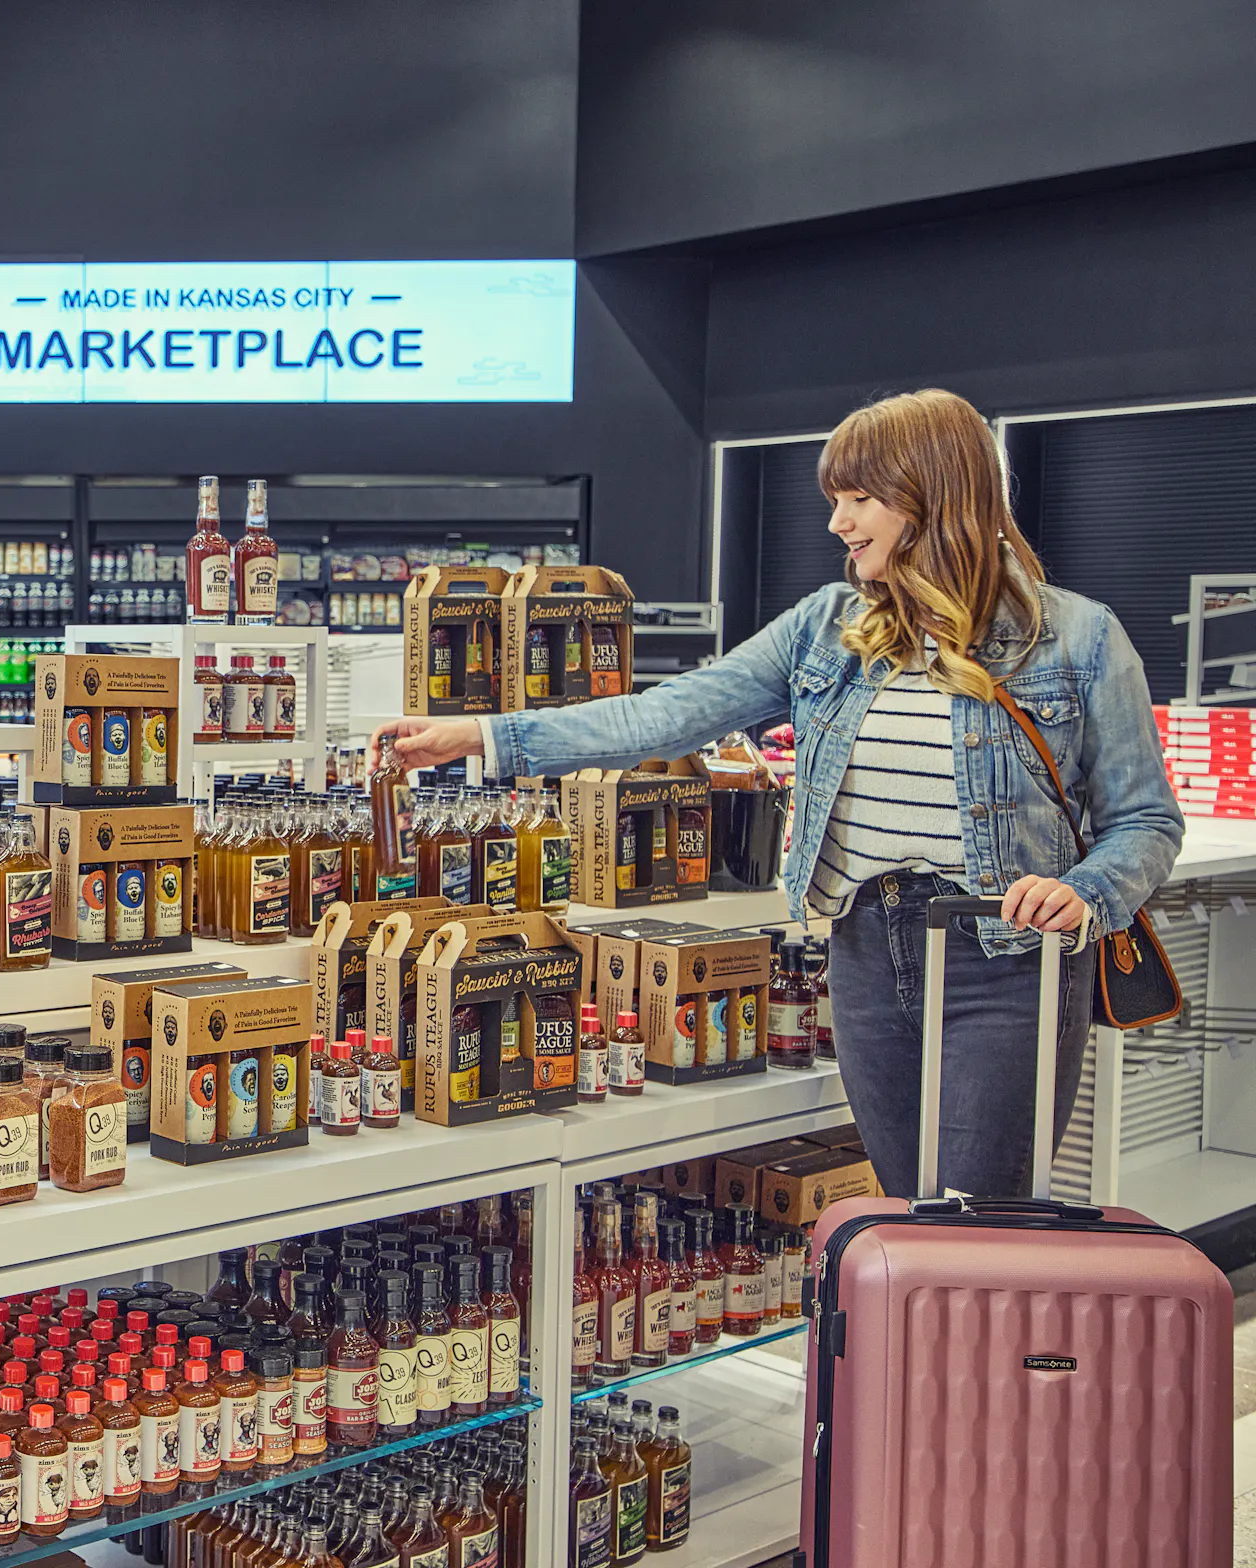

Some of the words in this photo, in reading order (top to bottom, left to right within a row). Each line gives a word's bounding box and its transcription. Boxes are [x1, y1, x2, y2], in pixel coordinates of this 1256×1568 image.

[63, 290, 136, 308] MADE
[146, 289, 169, 307] IN
[180, 288, 287, 308] KANSAS
[295, 288, 353, 307] CITY
[207, 585, 229, 594] WHISKE
[410, 603, 418, 660] TEAGUE
[508, 604, 516, 659] TEAGUE
[409, 665, 418, 708] RUFUS
[569, 786, 579, 849] TEAGUE
[595, 790, 604, 849] TEAGUE
[678, 843, 704, 852] AGUE
[569, 850, 578, 896] RUFUS
[594, 853, 603, 901] RUFUS
[489, 888, 516, 900] Vanilla
[262, 915, 285, 925] SPICE
[12, 926, 50, 946] Rhubarb
[23, 938, 44, 947] THYME
[317, 953, 327, 1023] TEAGUE
[456, 969, 512, 999] Saucin'
[514, 970, 523, 984] &
[541, 979, 557, 988] BBQ
[559, 977, 574, 986] KIT
[376, 962, 386, 1035] TEAGUE
[239, 1008, 263, 1019] Painfully
[264, 1007, 287, 1015] Delicious
[287, 1005, 298, 1013] Trio
[426, 973, 437, 1047] TEAGUE
[234, 1021, 241, 1029] of
[258, 1017, 272, 1026] Good
[273, 1016, 296, 1024] Favorites
[536, 1021, 573, 1035] UFUS
[458, 1031, 480, 1050] RUFU
[535, 1036, 572, 1049] EAGUE
[458, 1047, 480, 1064] TEAGU
[425, 1054, 436, 1113] RUFUS
[89, 1112, 112, 1134] Q39
[90, 1150, 105, 1162] PORK
[106, 1146, 118, 1158] RUB
[222, 1144, 241, 1152] Pain
[15, 1161, 29, 1173] RUB
[417, 1349, 443, 1368] Q39
[452, 1342, 478, 1362] Q39
[380, 1362, 406, 1382] Q39
[1027, 1359, 1071, 1368] Samsonite
[275, 1406, 292, 1417] JOE
